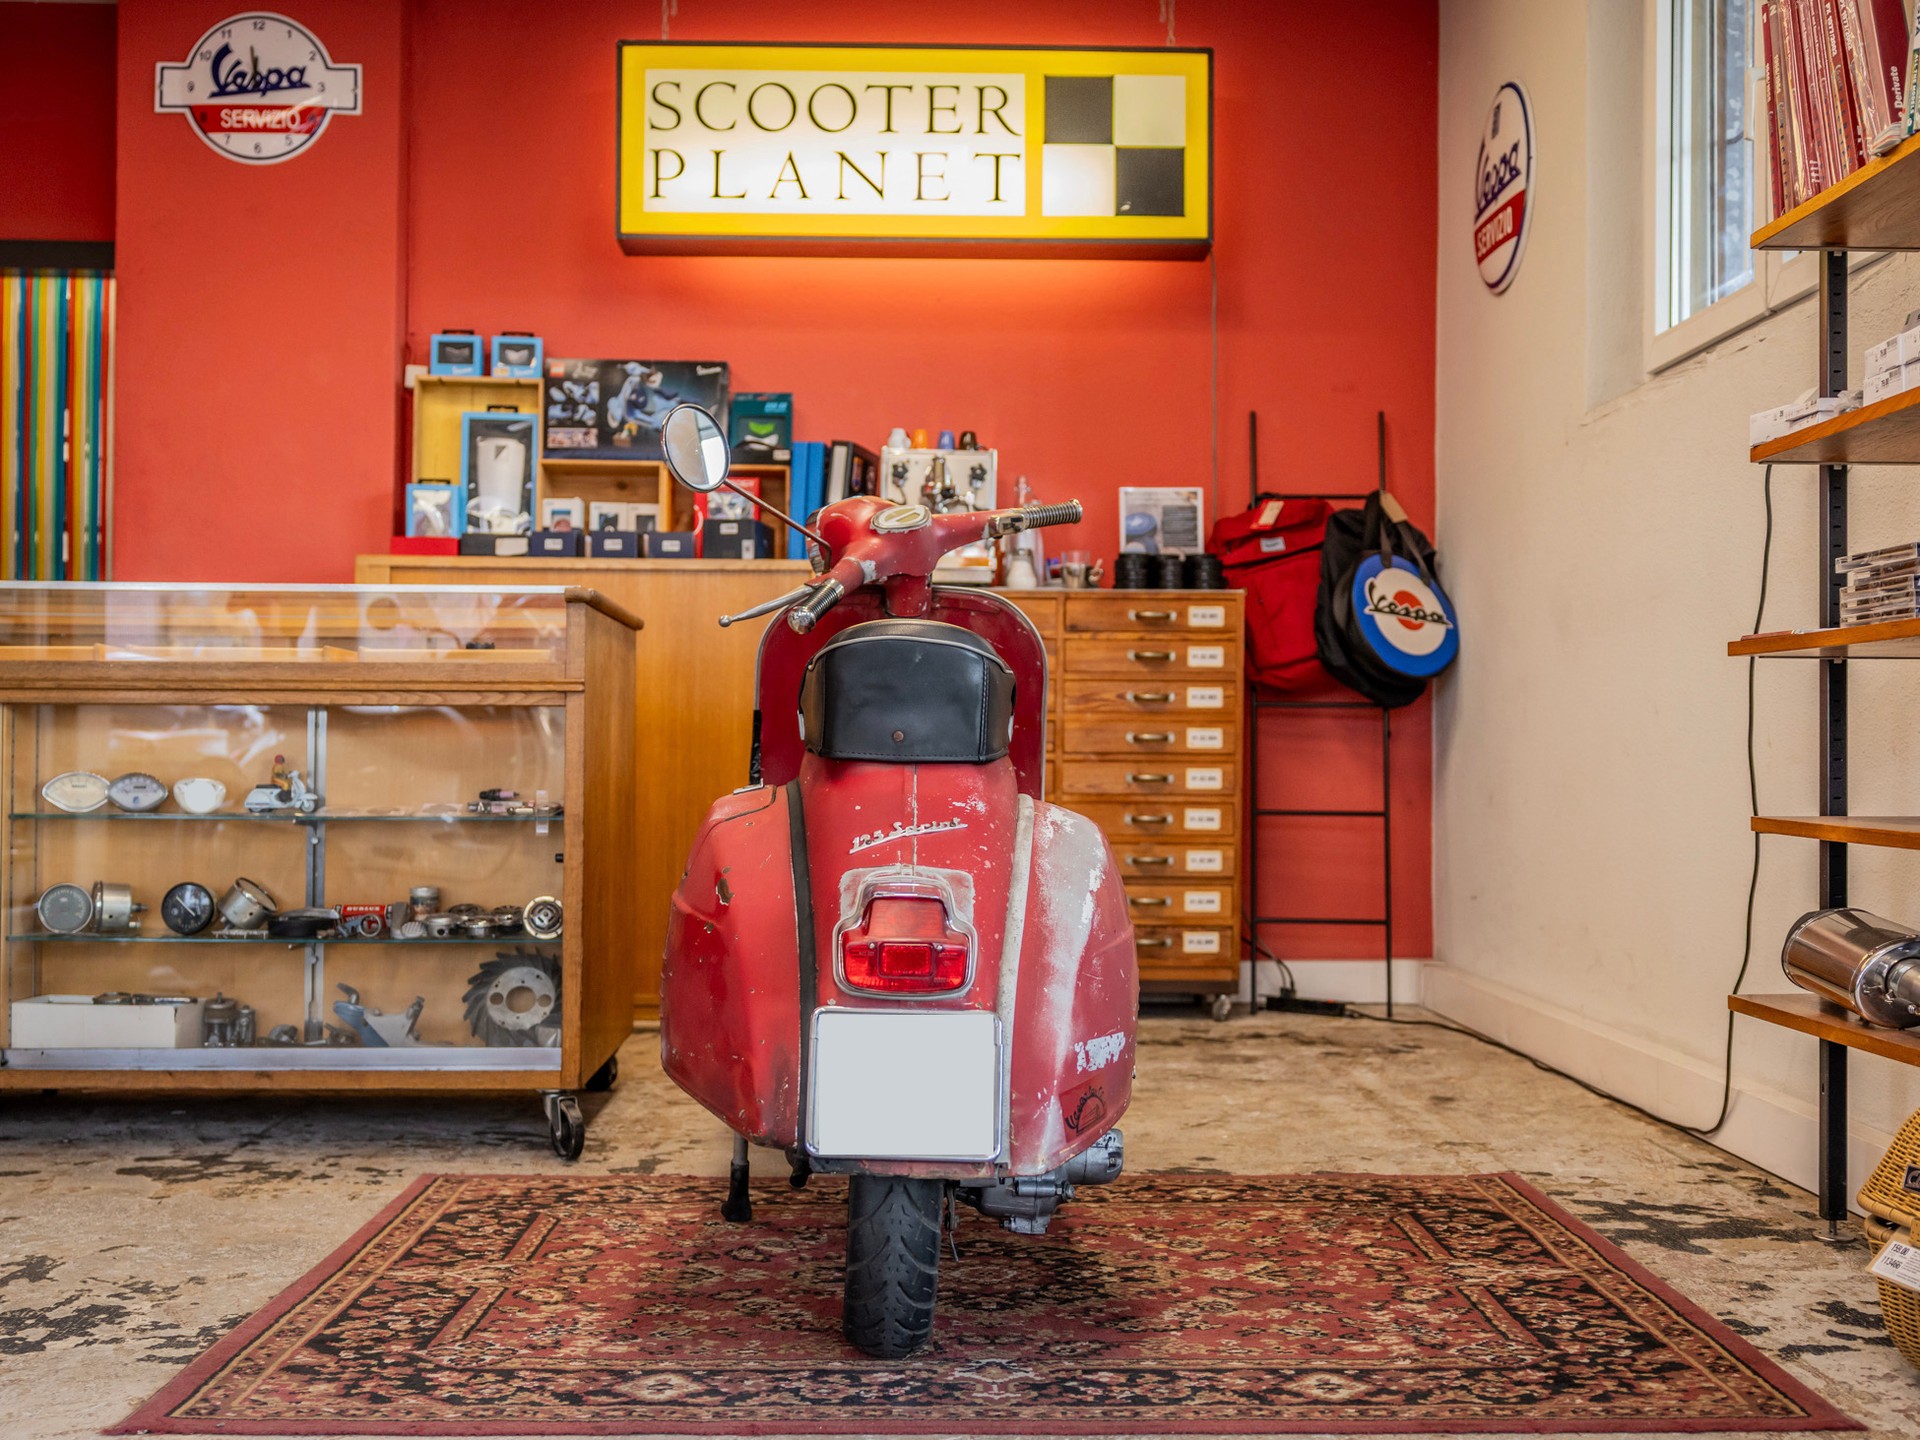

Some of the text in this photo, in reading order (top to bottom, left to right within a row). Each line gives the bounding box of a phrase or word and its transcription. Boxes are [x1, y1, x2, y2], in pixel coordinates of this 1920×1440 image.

[252, 21, 266, 30] 12
[221, 29, 232, 38] 11
[286, 30, 291, 38] 1
[200, 51, 212, 61] 10
[309, 51, 316, 61] 2
[187, 81, 195, 92] 9
[317, 82, 326, 92] 3
[1890, 65, 1903, 109] Derivate
[648, 80, 1023, 137] SCOOTER
[220, 108, 301, 129] SERVIZIO
[224, 134, 231, 144] 7
[285, 134, 293, 146] 5
[254, 142, 262, 154] 6
[648, 148, 1022, 203] PLANET
[1477, 205, 1513, 258] SERVIZIO
[1368, 581, 1451, 625] Vespa
[850, 830, 885, 850] 125
